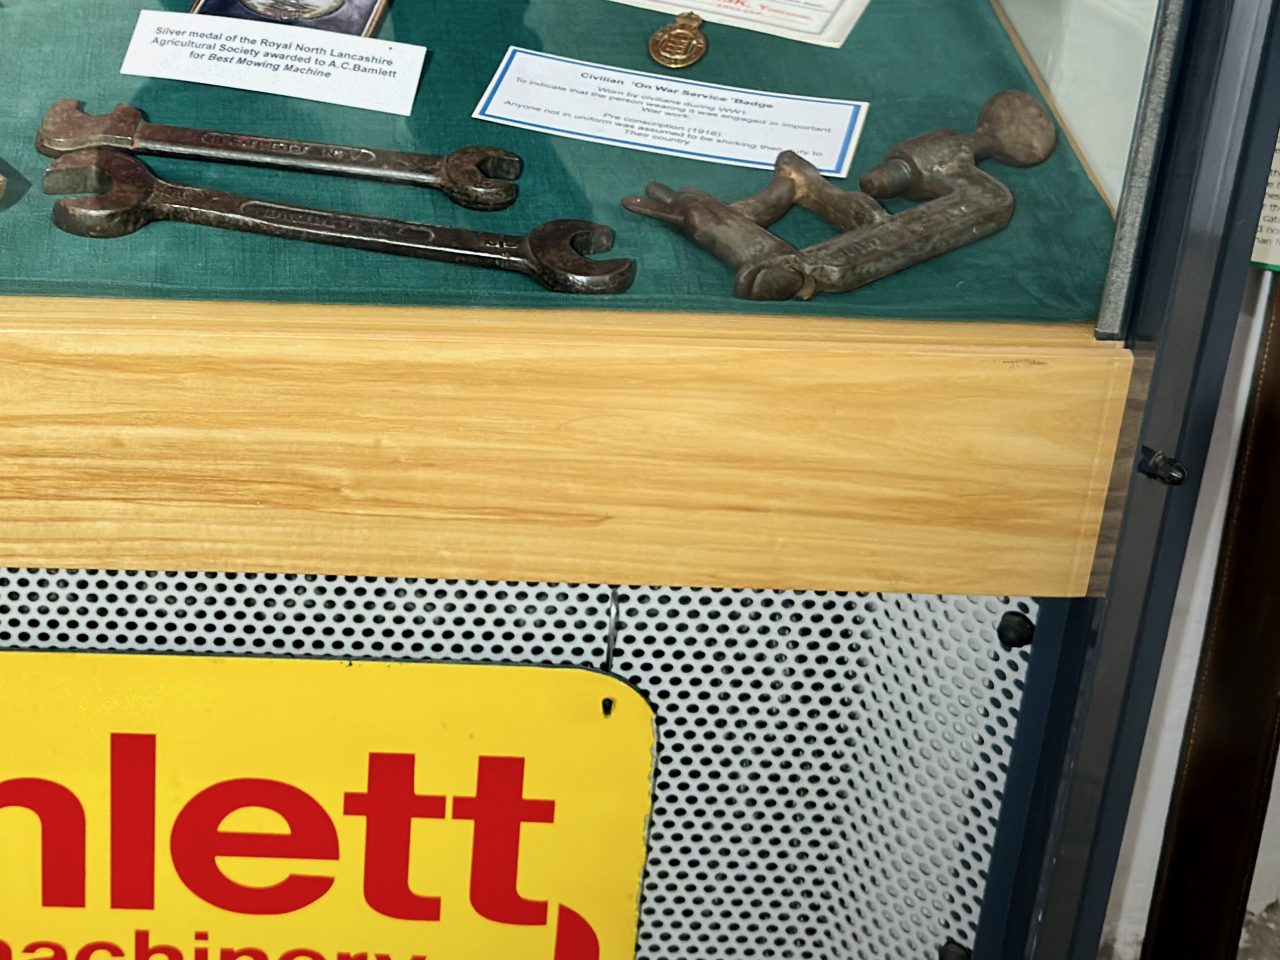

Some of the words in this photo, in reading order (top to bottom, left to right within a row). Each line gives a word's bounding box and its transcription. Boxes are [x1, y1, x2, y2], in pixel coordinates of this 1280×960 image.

[152, 36, 217, 51] Agricultural
[219, 44, 260, 58] Society
[263, 50, 312, 65] awarded
[314, 57, 326, 66] to
[328, 59, 397, 78] A.C.Bamlett
[155, 26, 186, 37] Silver
[189, 29, 222, 41] medal
[225, 33, 238, 42] of
[240, 34, 257, 46] the
[260, 38, 292, 51] Royal
[295, 43, 327, 56] North
[330, 48, 394, 66] Lancashire
[189, 50, 206, 60] for
[208, 52, 234, 64] Best
[236, 56, 280, 72] Mowing
[282, 62, 332, 78] Machine
[580, 72, 624, 85] Civilian
[656, 84, 679, 94] War
[682, 90, 728, 102] Service
[597, 86, 624, 96] Worn
[627, 90, 640, 100] by
[641, 93, 682, 105] civilians
[683, 100, 716, 112] during
[516, 76, 527, 84] To
[529, 79, 567, 92] indicate
[570, 86, 588, 96] that
[590, 90, 607, 100] the
[608, 95, 644, 107] person
[646, 101, 687, 114] wearing
[698, 110, 719, 118] was
[721, 114, 767, 126] engaged
[781, 122, 832, 134] important
[641, 106, 663, 115] War
[504, 100, 542, 113] Anyone
[544, 106, 561, 116] not
[574, 114, 612, 126] uniform
[614, 120, 636, 129] was
[638, 124, 685, 138] assumed
[687, 132, 698, 140] to
[700, 134, 714, 142] be
[716, 136, 757, 150] shirking
[760, 144, 783, 152] their
[603, 112, 622, 122] Pre
[624, 116, 685, 132] conscription
[624, 129, 650, 139] Their
[652, 134, 690, 146] country
